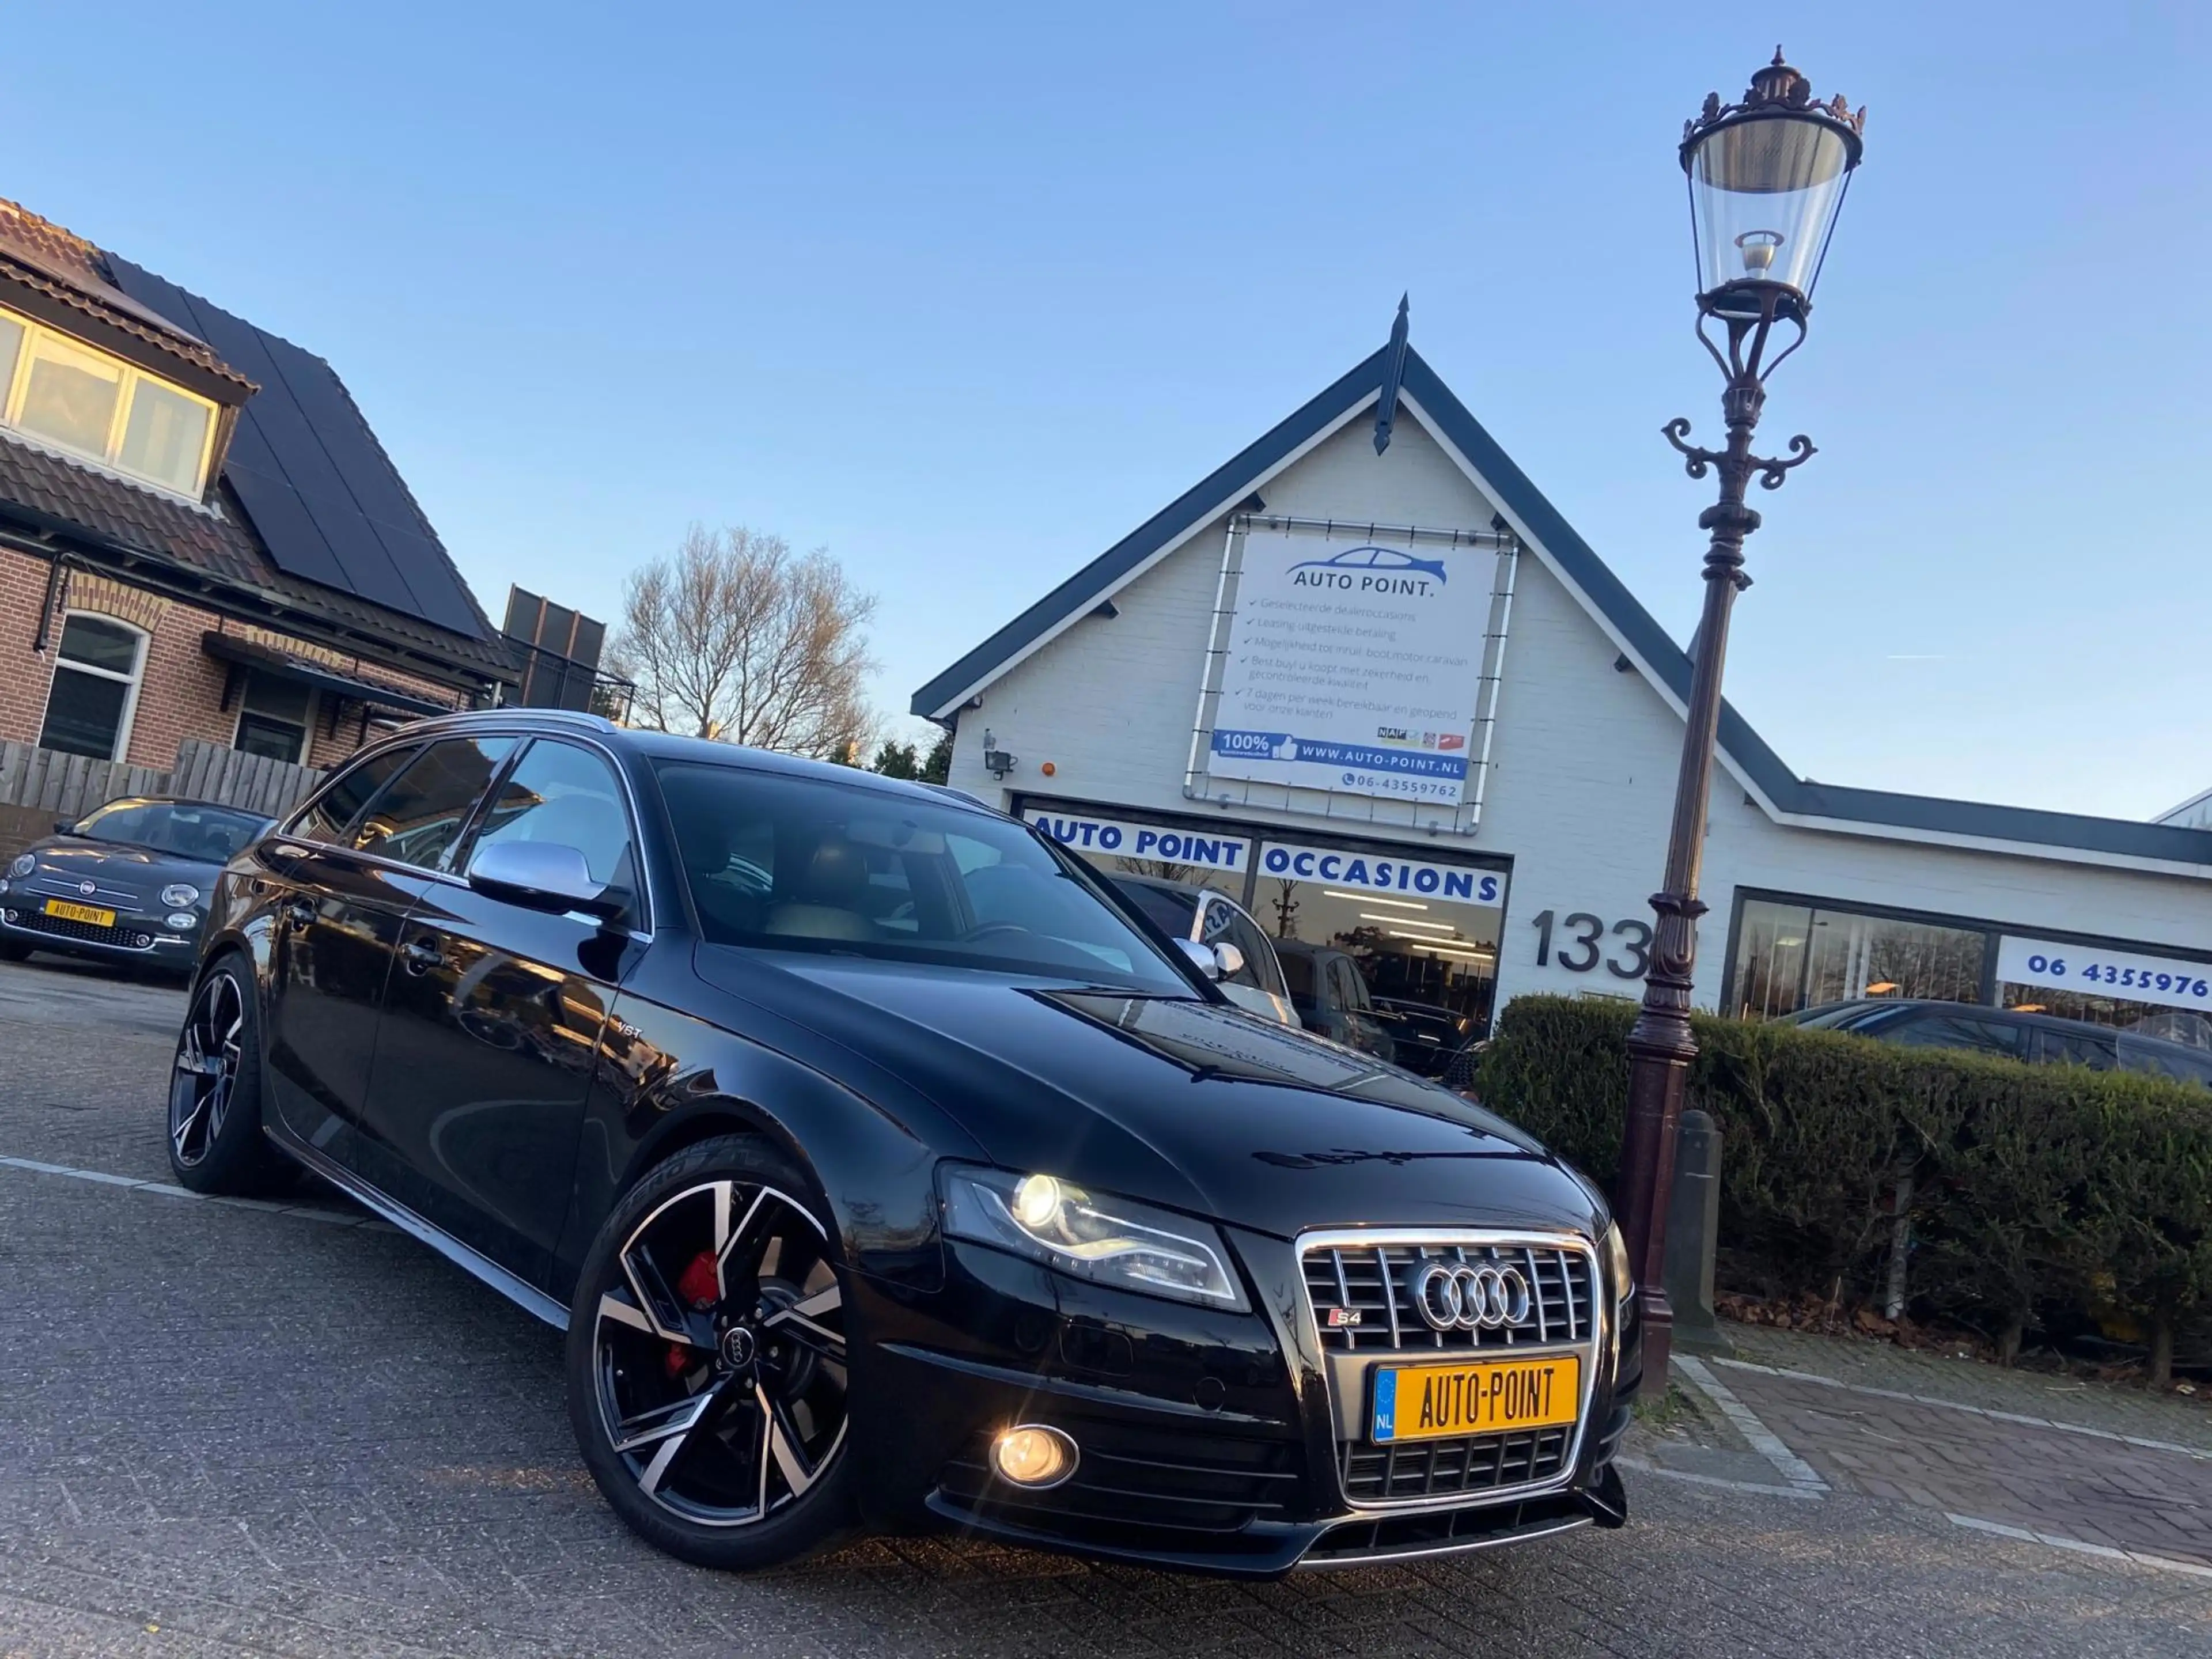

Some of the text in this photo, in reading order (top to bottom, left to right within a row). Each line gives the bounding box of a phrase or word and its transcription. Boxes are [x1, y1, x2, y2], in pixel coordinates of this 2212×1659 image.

[1293, 571, 1353, 589] AUTO
[1251, 656, 1273, 666] Best
[1339, 665, 1359, 675] met
[1244, 702, 1265, 711] voor
[1254, 689, 1286, 703] dagen
[1288, 694, 1305, 704] per
[1223, 734, 1269, 751] 100%
[1302, 745, 1460, 774] WWW.AUTO-POINT.NL
[1356, 775, 1457, 797] 06-43559762
[1136, 830, 1243, 866] POINT
[1265, 849, 1498, 902] OCCASIONS
[55, 904, 107, 923] AUTO-POINT
[1532, 910, 1653, 979] 133
[2028, 955, 2066, 976] 06
[1336, 1312, 1362, 1326] S4
[1377, 1368, 1555, 1430] NL AUTO-POINT
